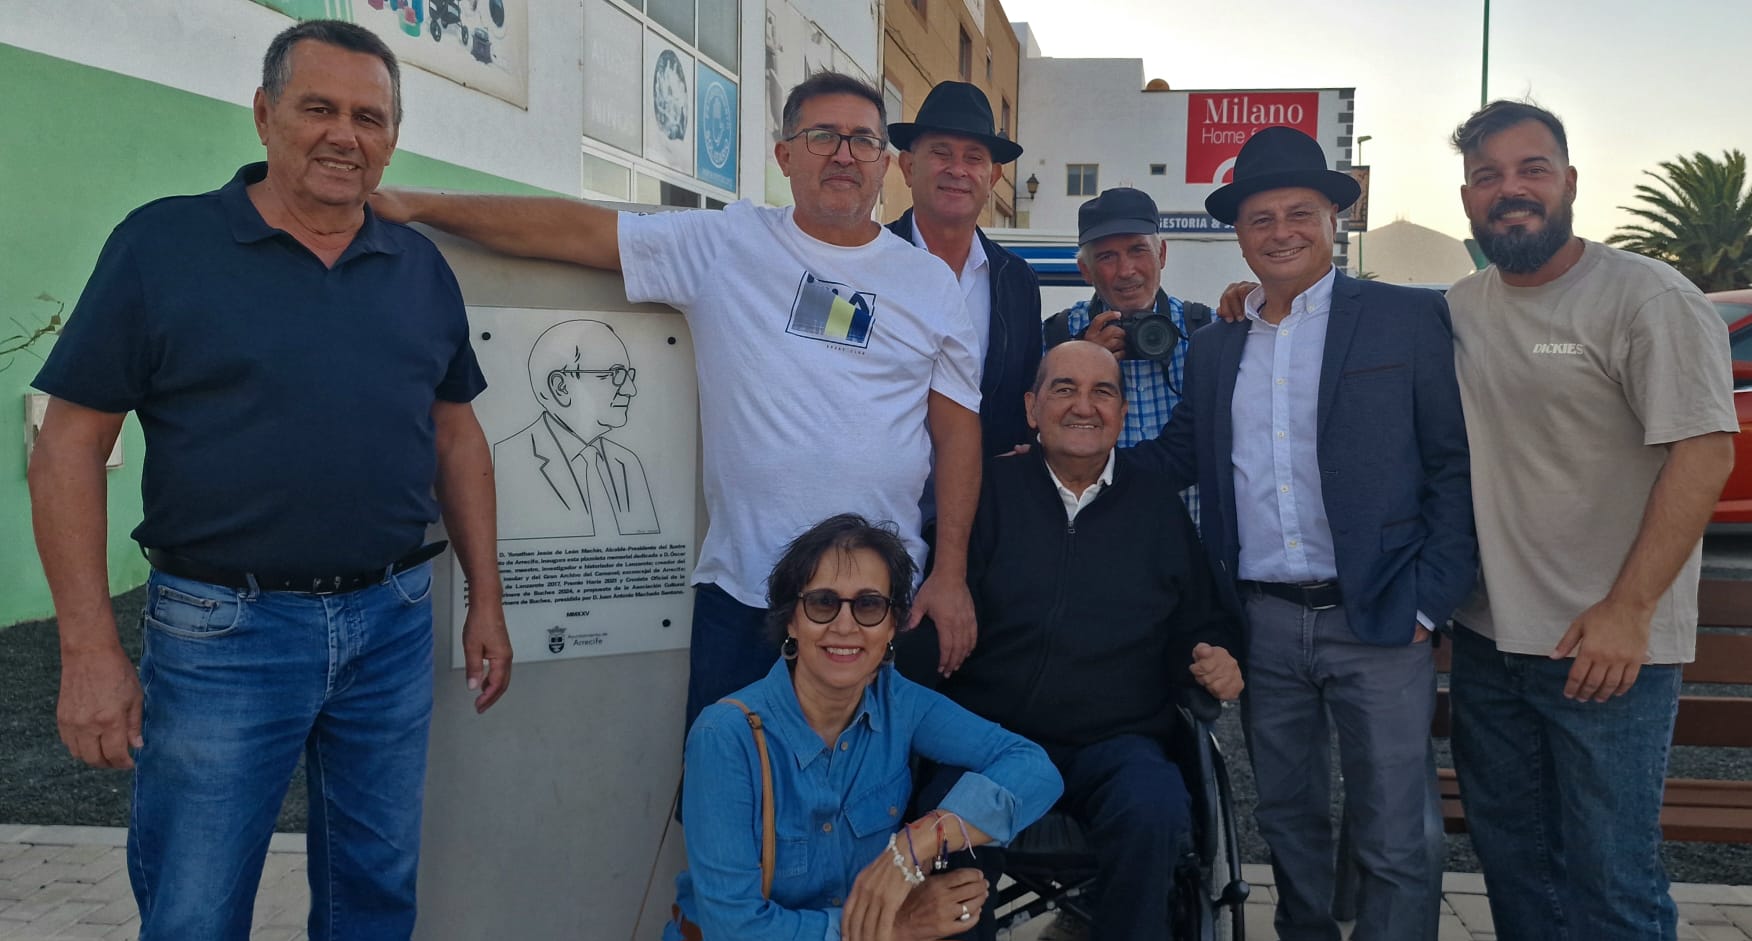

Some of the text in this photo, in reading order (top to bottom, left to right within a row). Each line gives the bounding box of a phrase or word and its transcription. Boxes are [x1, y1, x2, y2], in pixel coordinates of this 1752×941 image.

[1203, 96, 1304, 125] Milano
[1202, 127, 1245, 145] Home
[1532, 343, 1584, 355] DICKIES
[573, 637, 603, 646] Arrecife
